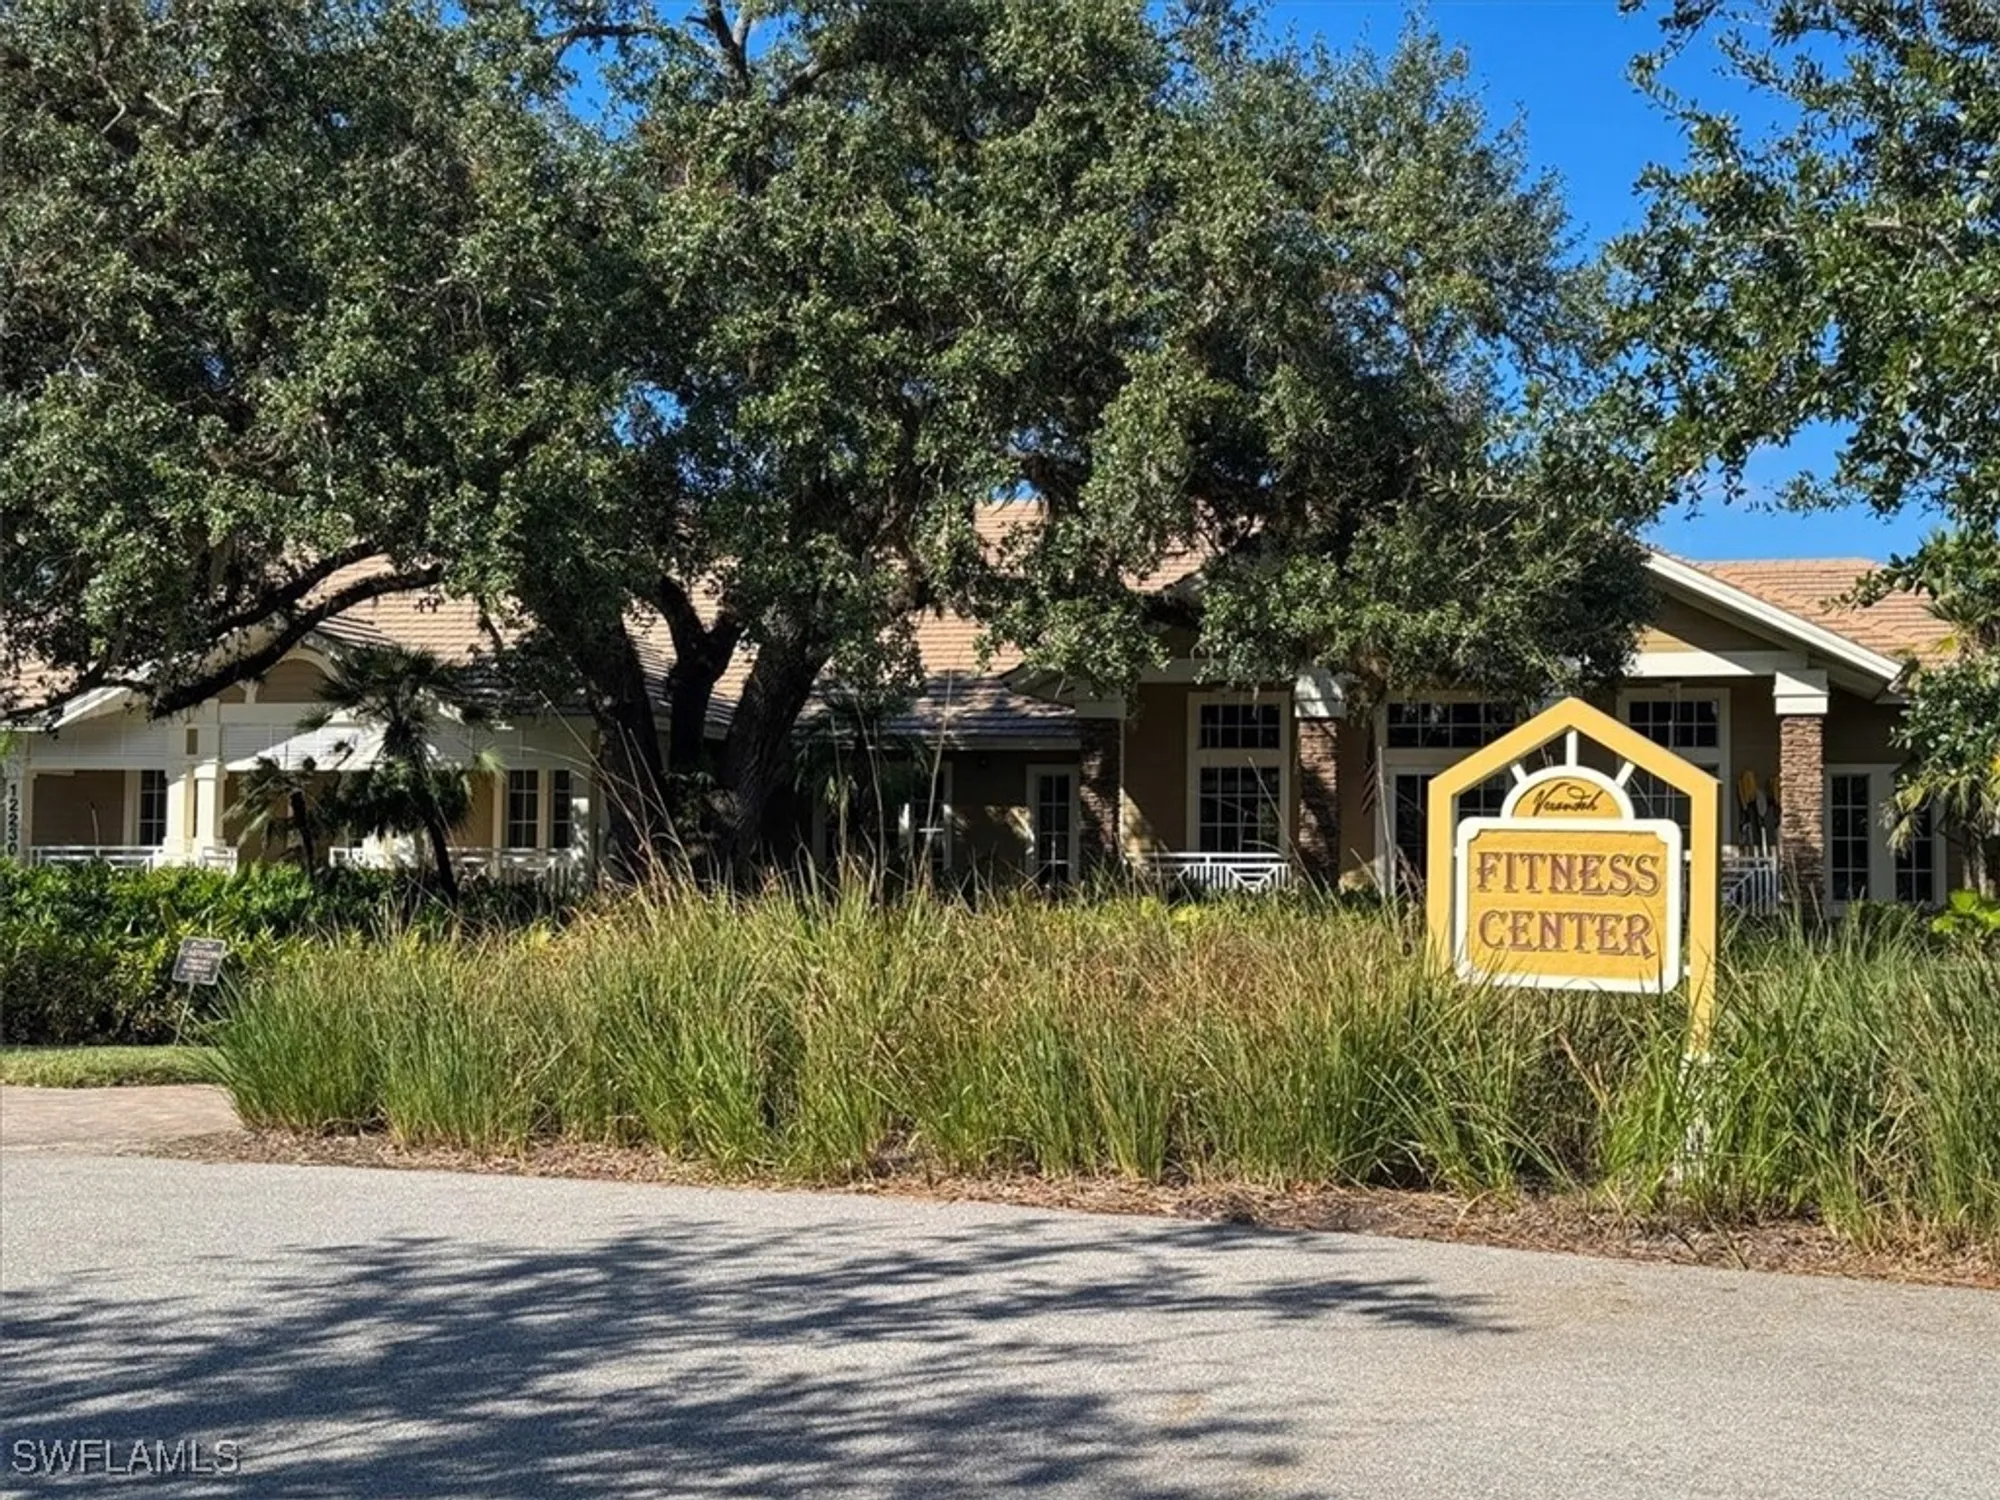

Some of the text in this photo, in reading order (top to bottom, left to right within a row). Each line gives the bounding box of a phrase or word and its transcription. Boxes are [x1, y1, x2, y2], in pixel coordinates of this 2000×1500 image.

[8, 783, 18, 856] 12230
[1476, 851, 1660, 896] FITNESS
[1479, 910, 1657, 960] CENTER
